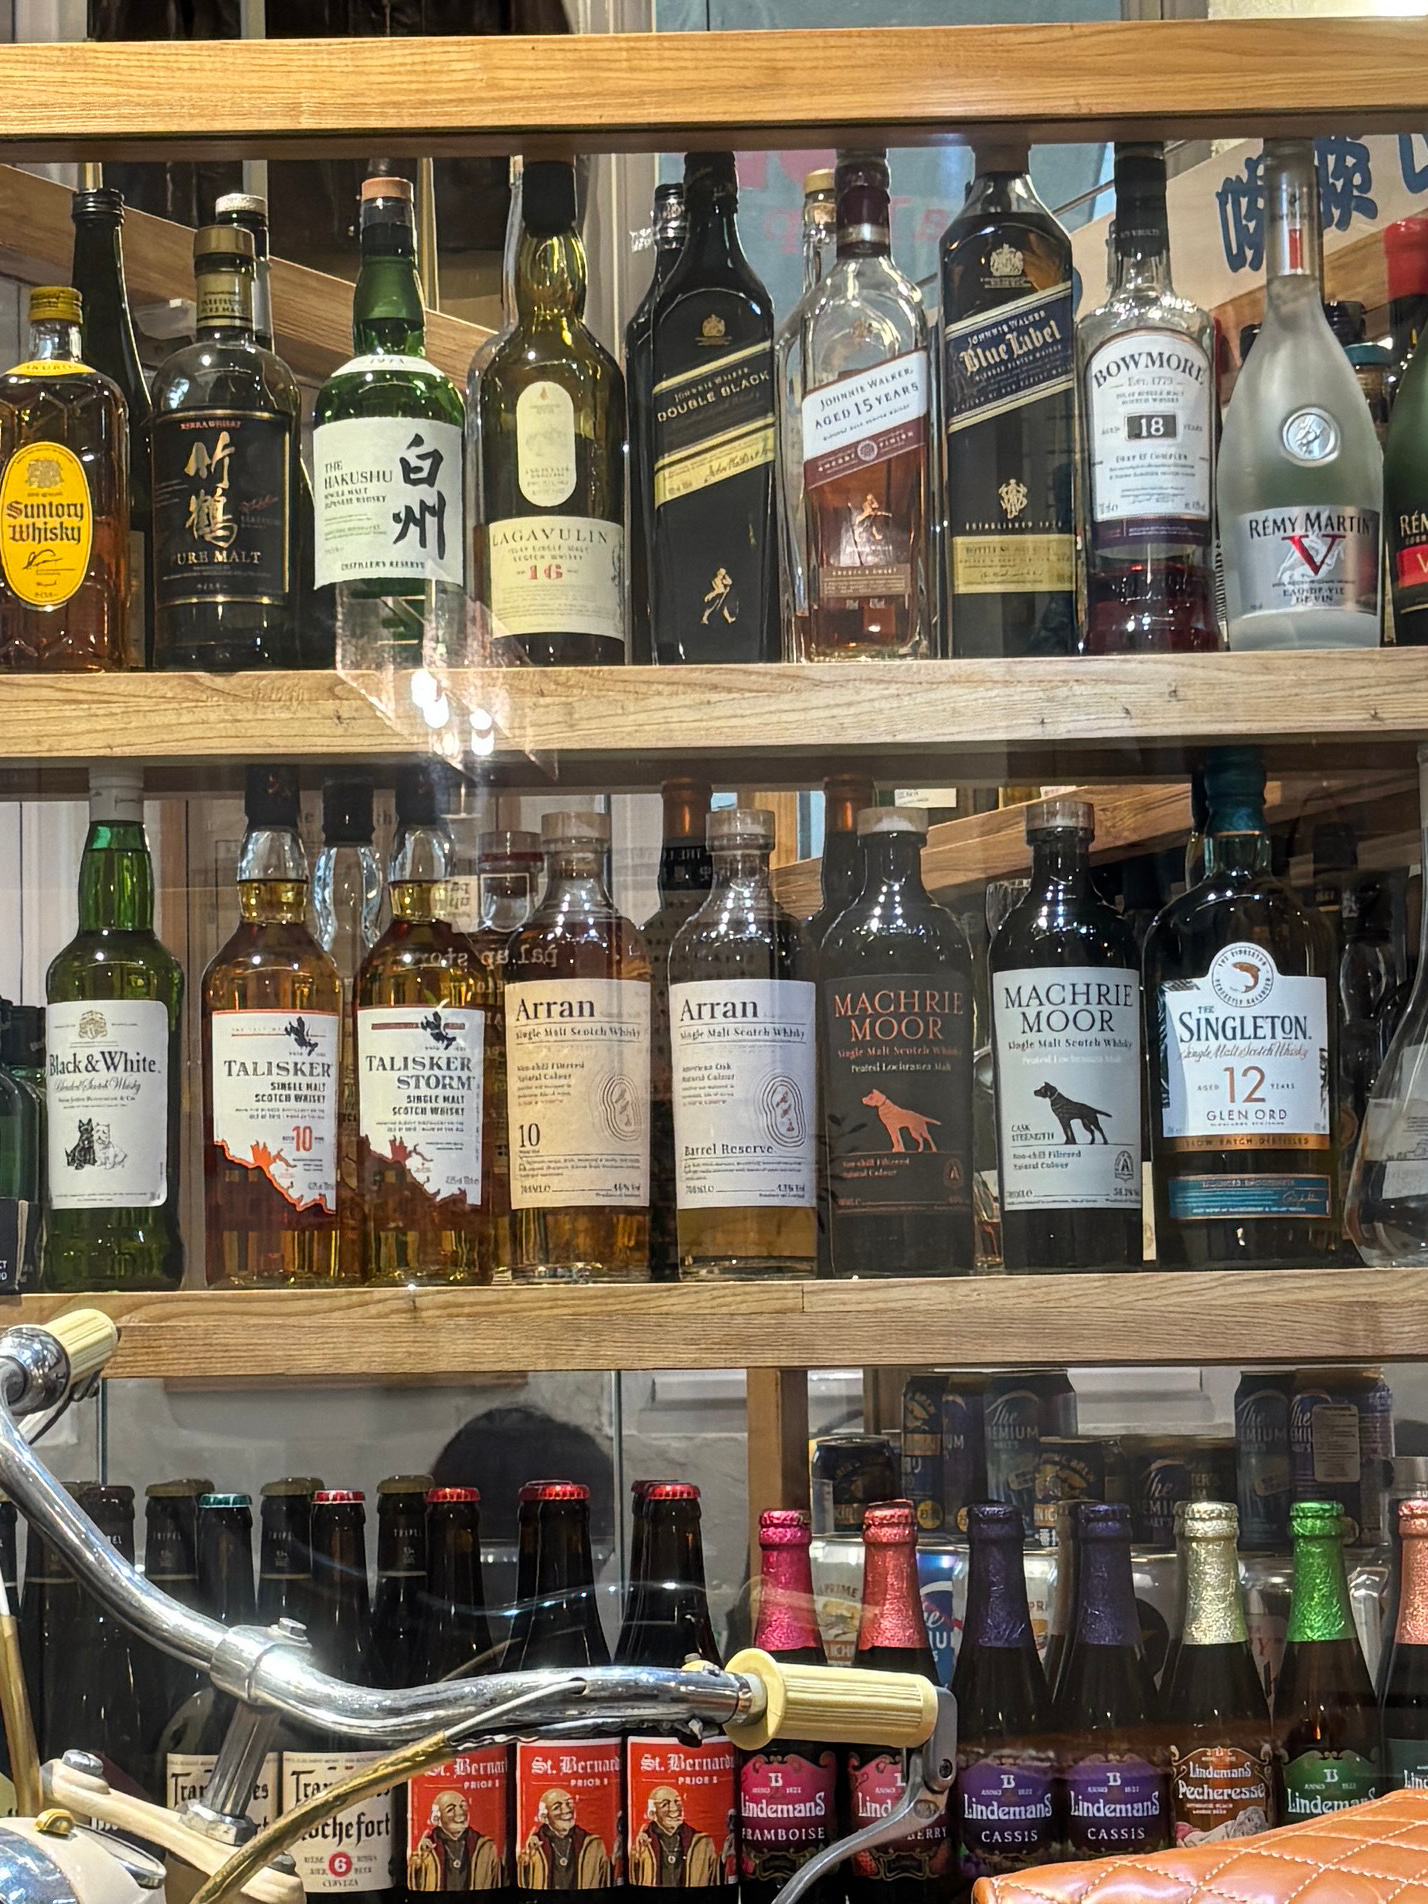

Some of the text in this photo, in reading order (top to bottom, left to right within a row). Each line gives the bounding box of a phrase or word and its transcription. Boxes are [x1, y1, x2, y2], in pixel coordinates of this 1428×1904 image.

[960, 320, 1062, 376] Blue Label
[1092, 351, 1204, 389] BOWMORE
[657, 370, 770, 422] DOUBLE BLACK
[814, 408, 852, 430] AGED
[854, 399, 873, 417] 15
[875, 382, 919, 407] YEARS
[820, 385, 865, 411] JOHNNIE
[1139, 417, 1164, 436] 18
[324, 460, 344, 475] THE
[324, 470, 393, 490] HAKUSHU
[392, 433, 446, 560] 白州
[7, 501, 84, 522] Suntory
[8, 523, 82, 545] Whisky
[492, 527, 609, 545] LAGAVULIN
[1249, 512, 1370, 540] RÉMY MARTIN
[214, 551, 261, 565] MALT
[529, 564, 563, 580] 16
[834, 990, 963, 1018] MACHRIE
[1004, 983, 1133, 1009] MACHRIE
[516, 998, 596, 1022] Arran
[680, 999, 759, 1022] Arran
[850, 1016, 944, 1042] MOOR
[1020, 1009, 1115, 1034] MOOR
[571, 1027, 607, 1038] Scotch
[733, 1028, 770, 1038] Scotch
[1038, 1038, 1061, 1048] Malt
[224, 1060, 331, 1078] TALISKER
[366, 1055, 473, 1073] TALISKER
[271, 1082, 303, 1092] SINGLE
[397, 1074, 474, 1092] STORM
[1223, 1066, 1266, 1103] 12
[255, 1094, 291, 1103] SCOTCH
[406, 1095, 465, 1104] SINGLE MALT
[392, 1107, 465, 1116] SCOTCH WHISKY
[1206, 1109, 1287, 1121] GLEN ORD
[292, 1126, 312, 1152] 10
[518, 1123, 540, 1147] 10
[684, 1145, 774, 1156] Barrel Reserve
[1178, 1780, 1265, 1800] Pecheresse
[301, 1812, 390, 1847] ochefort
[981, 1830, 1038, 1843] CASSIS
[1087, 1827, 1145, 1840] CASSIS
